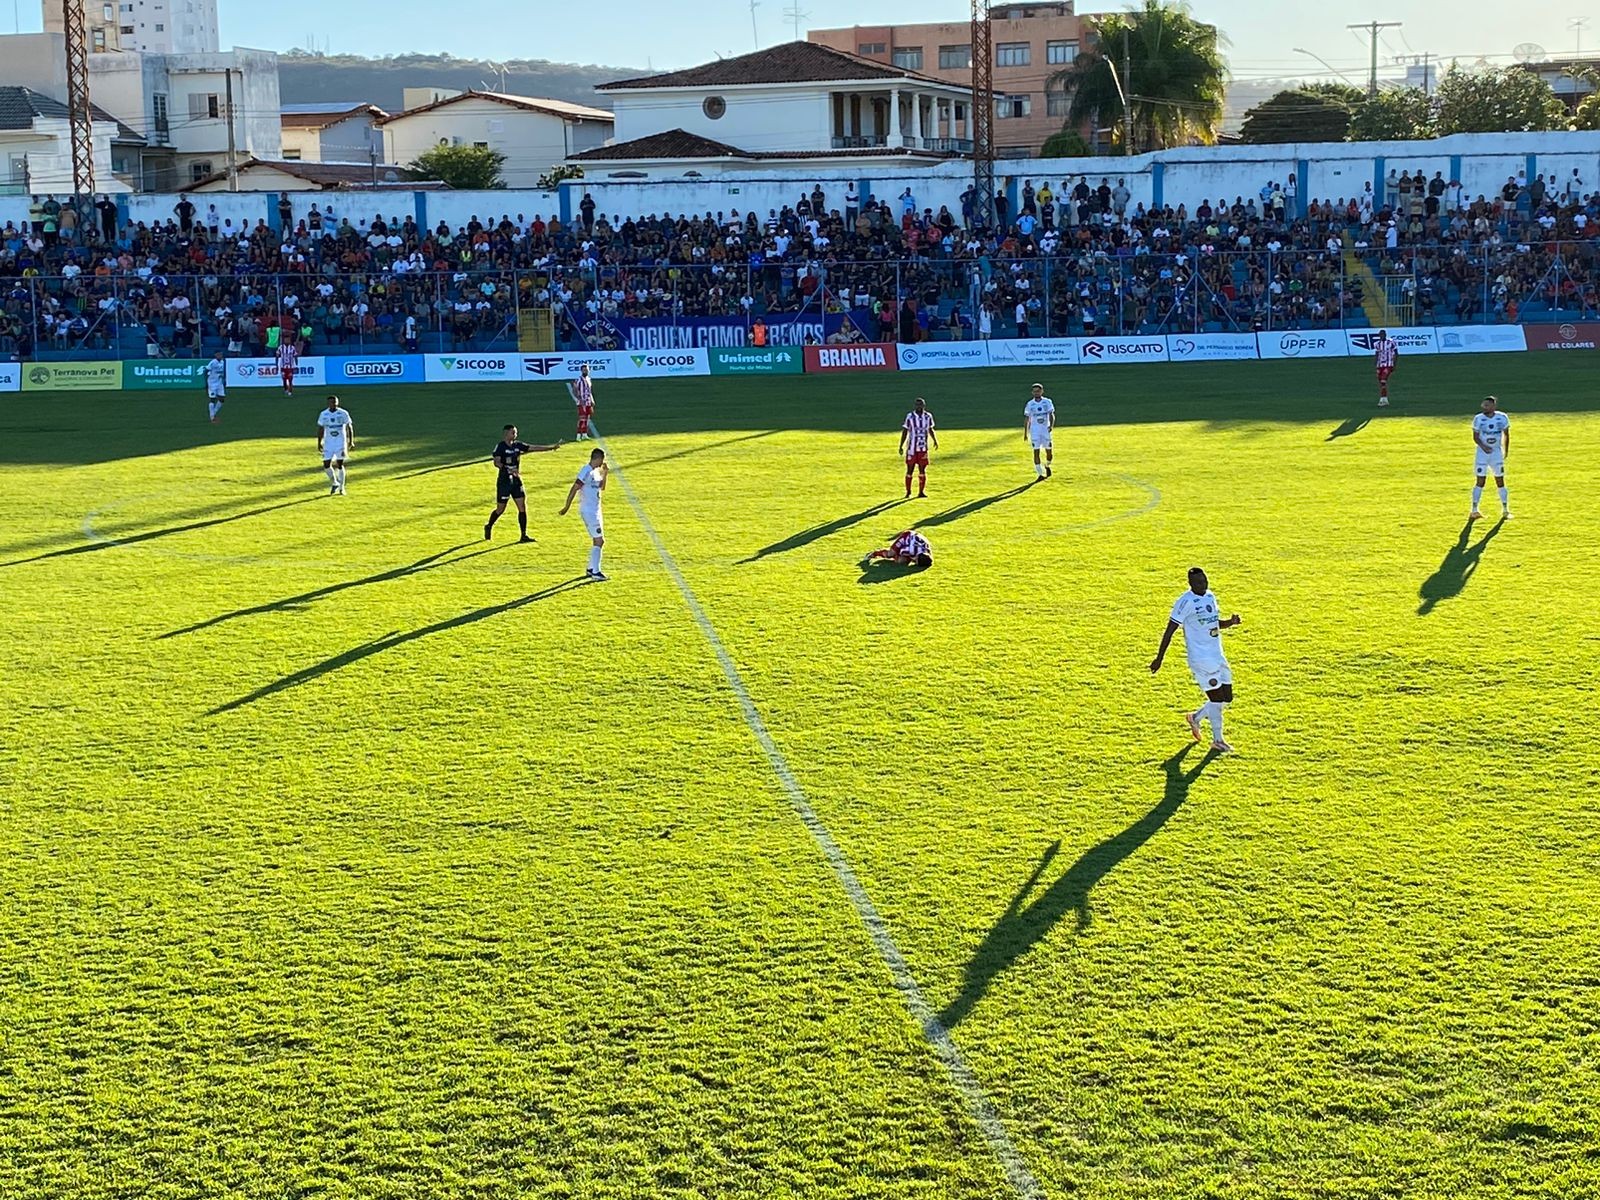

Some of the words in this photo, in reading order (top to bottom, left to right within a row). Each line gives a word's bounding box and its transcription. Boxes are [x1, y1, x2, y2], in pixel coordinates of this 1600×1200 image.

[625, 325, 693, 350] JOGUEM
[697, 325, 745, 349] COMO
[1107, 343, 1164, 354] RISCATTO
[1280, 338, 1326, 350] UPPER
[719, 353, 772, 363] Unimed
[819, 348, 886, 367] BRAHMA
[961, 349, 982, 357] VISÃO
[456, 360, 506, 370] SICOOB
[646, 355, 695, 366] SICOOB
[53, 368, 98, 377] Terranova
[134, 365, 192, 376] Unimed
[346, 362, 400, 374] BERRY'S
